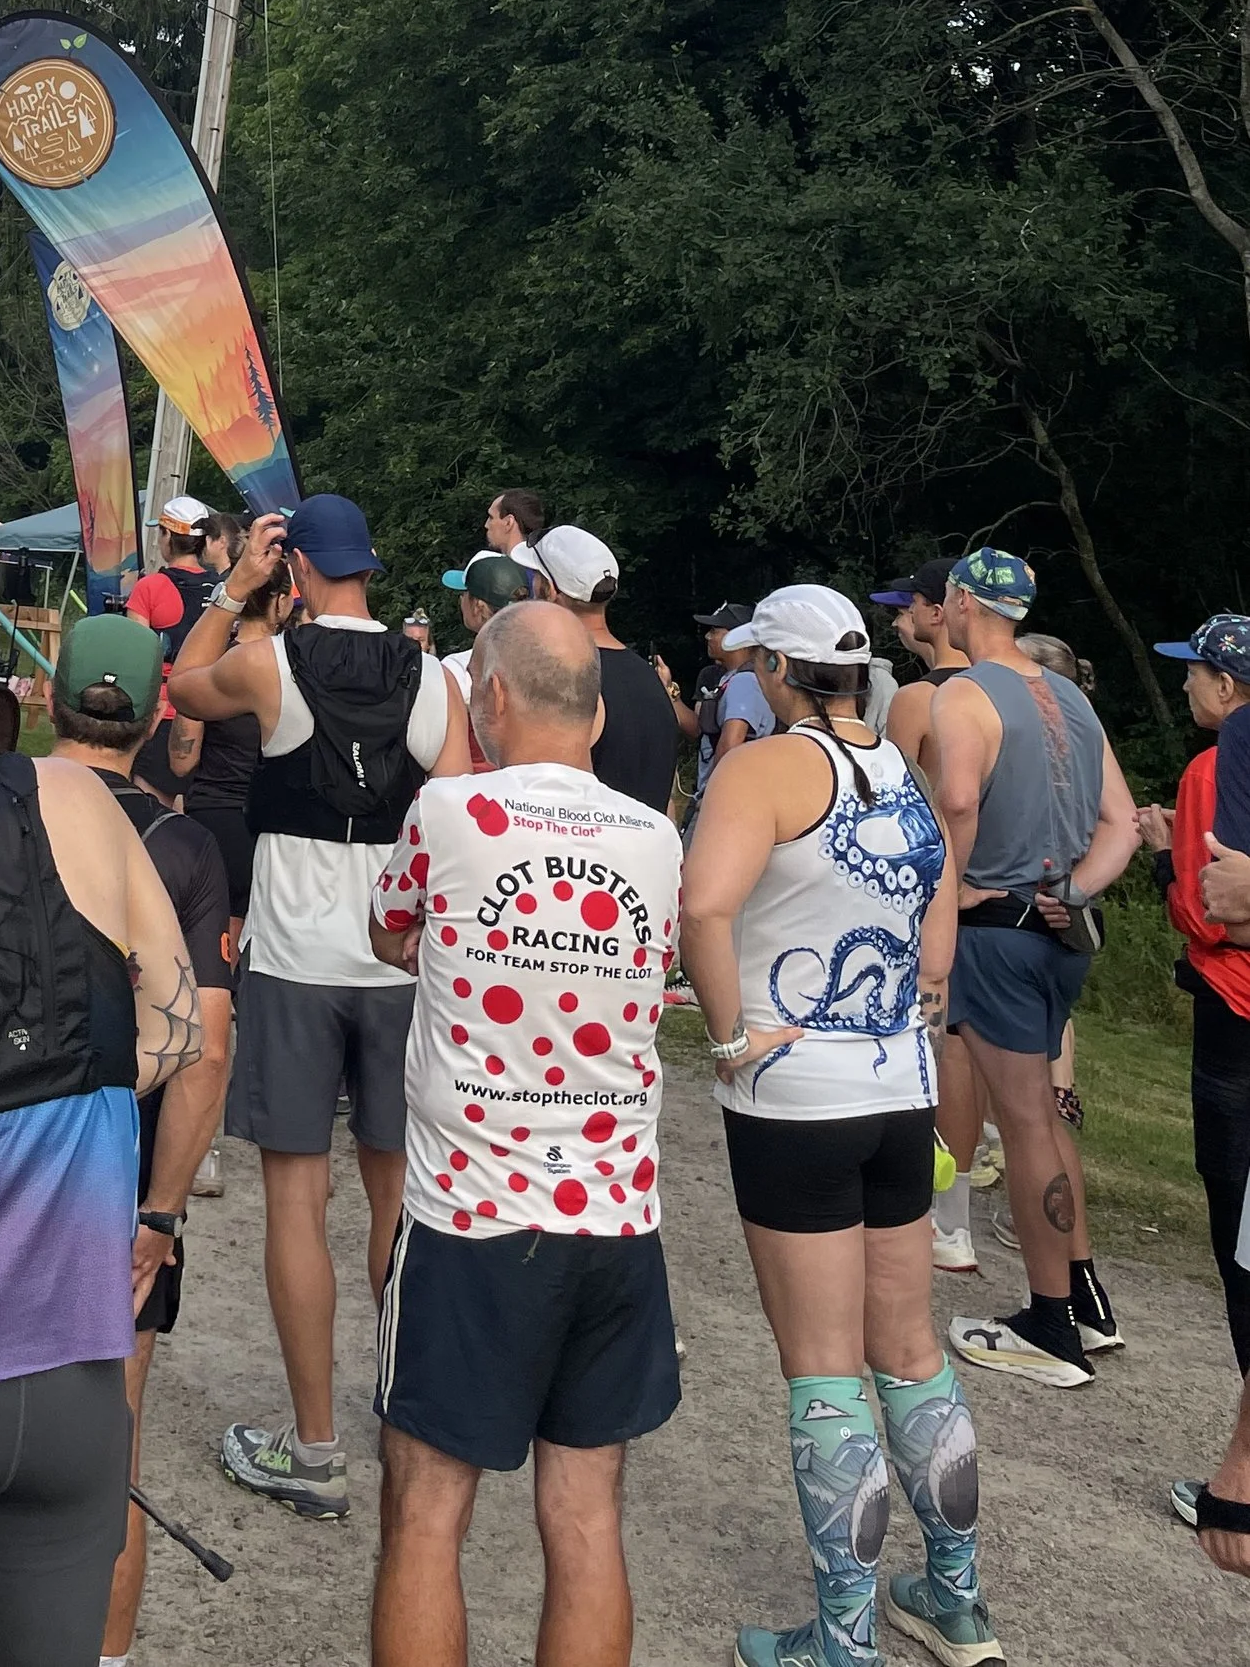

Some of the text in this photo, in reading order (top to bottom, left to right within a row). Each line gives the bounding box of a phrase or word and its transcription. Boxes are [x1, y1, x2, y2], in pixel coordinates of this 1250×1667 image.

[6, 76, 56, 118] HAPPY
[20, 102, 77, 138] TRAILS
[504, 799, 655, 830] National Blood Clot Alliance
[513, 816, 543, 831] Stop
[545, 821, 568, 835] The
[477, 856, 652, 944] CLOT BUSTERS
[512, 925, 620, 956] RACING
[466, 947, 652, 979] FOR TEAM STOP THE CLOT
[454, 1079, 648, 1106] www.stoptheclot.org
